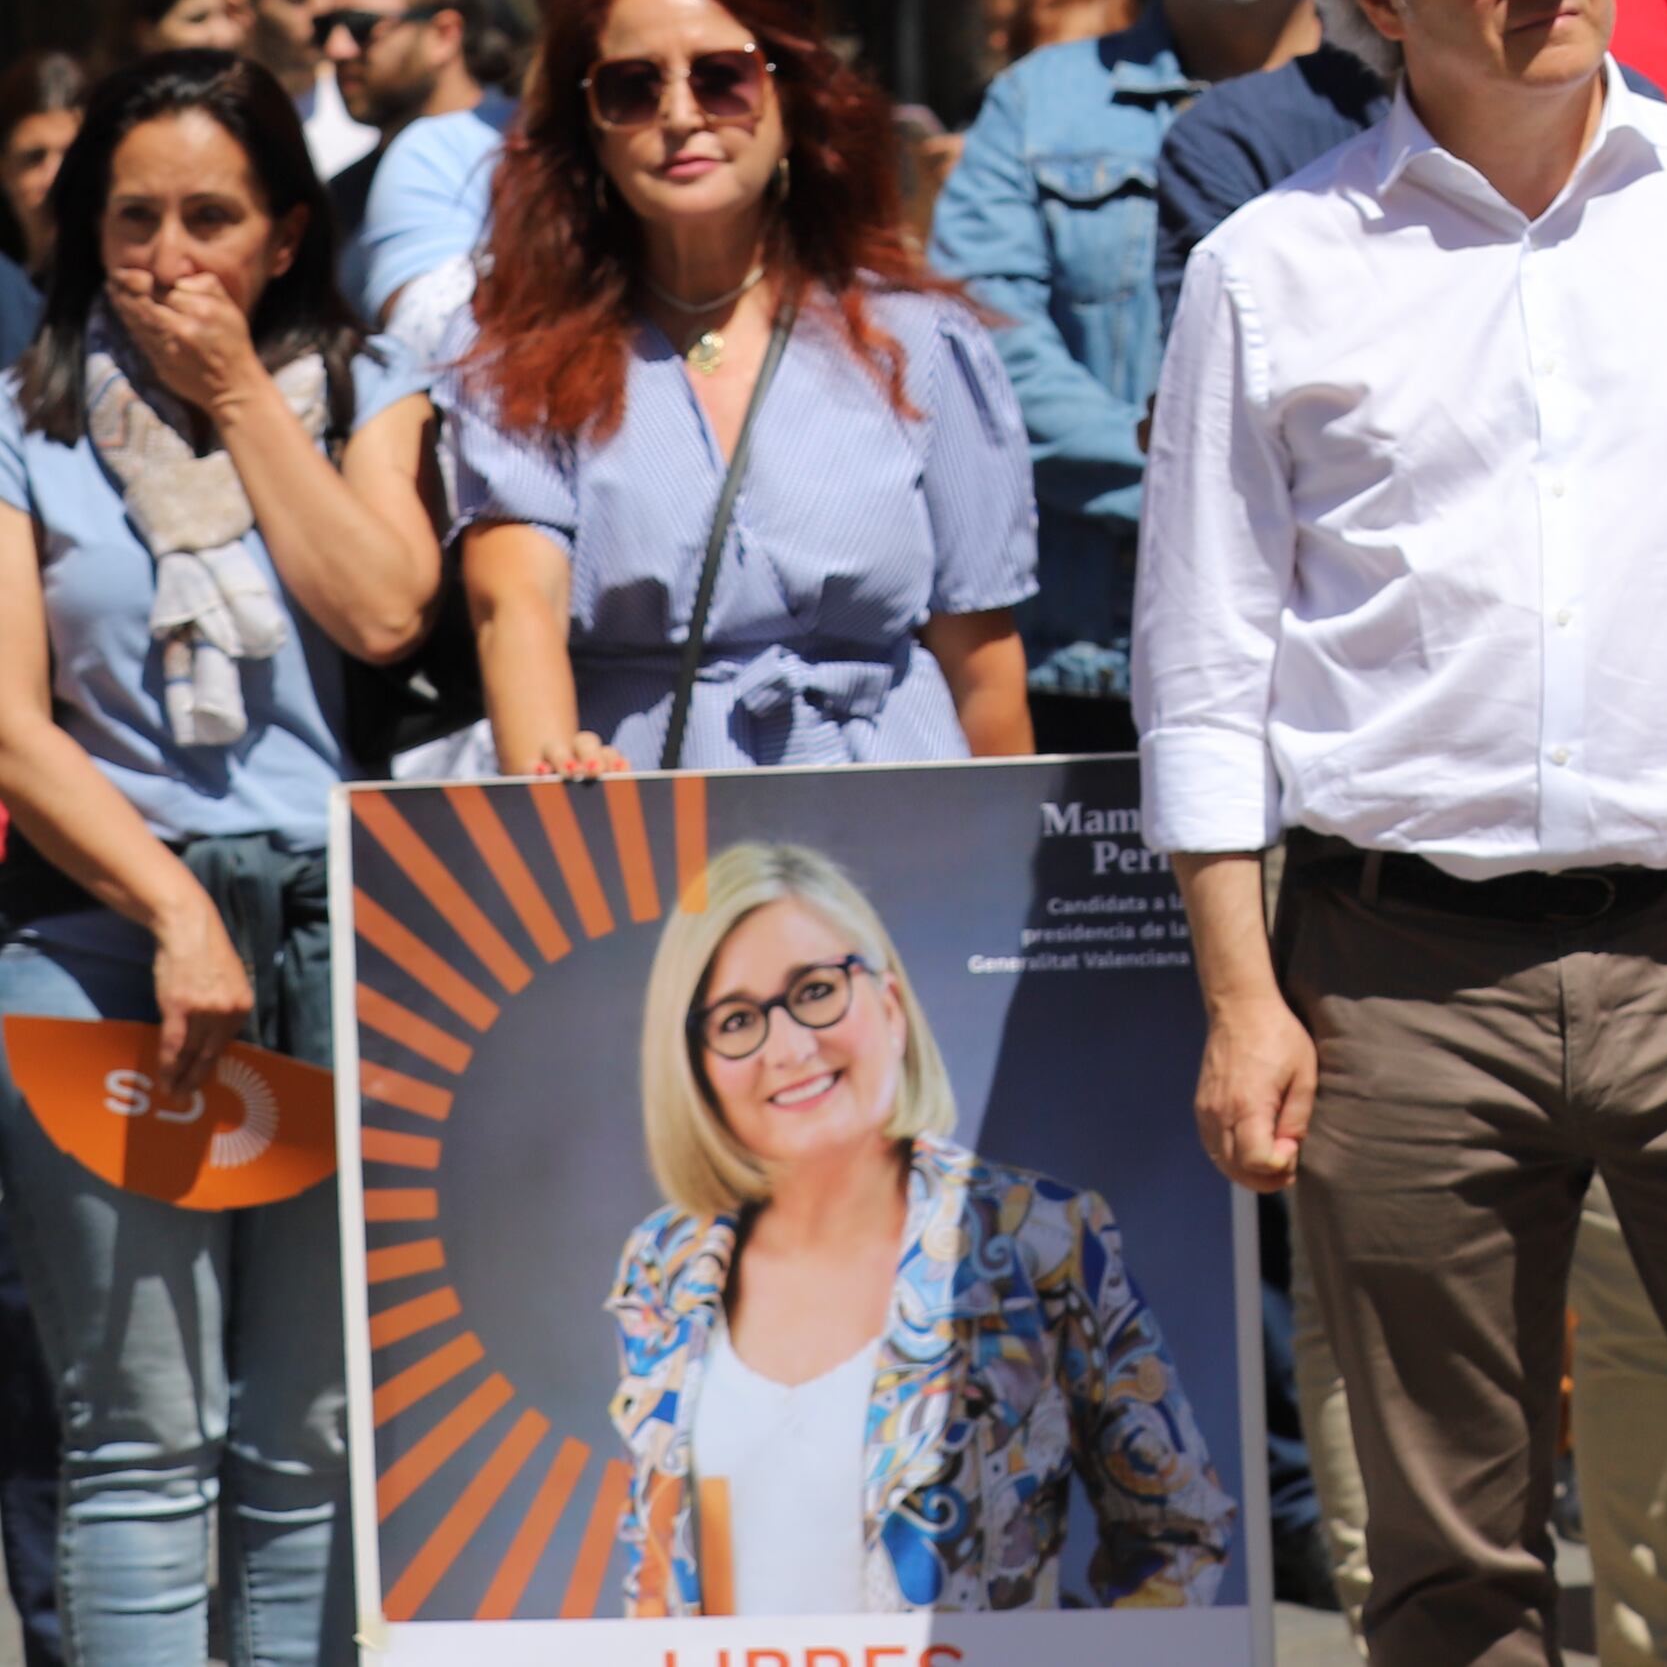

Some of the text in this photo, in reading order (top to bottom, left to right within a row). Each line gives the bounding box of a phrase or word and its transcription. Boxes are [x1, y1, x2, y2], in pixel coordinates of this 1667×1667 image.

[1040, 801, 1141, 836] Mam
[1046, 895, 1147, 916] Candidata
[1153, 896, 1165, 911] a
[1021, 919, 1189, 949] presidencia de la
[967, 948, 1191, 974] Generalitat Valenciana
